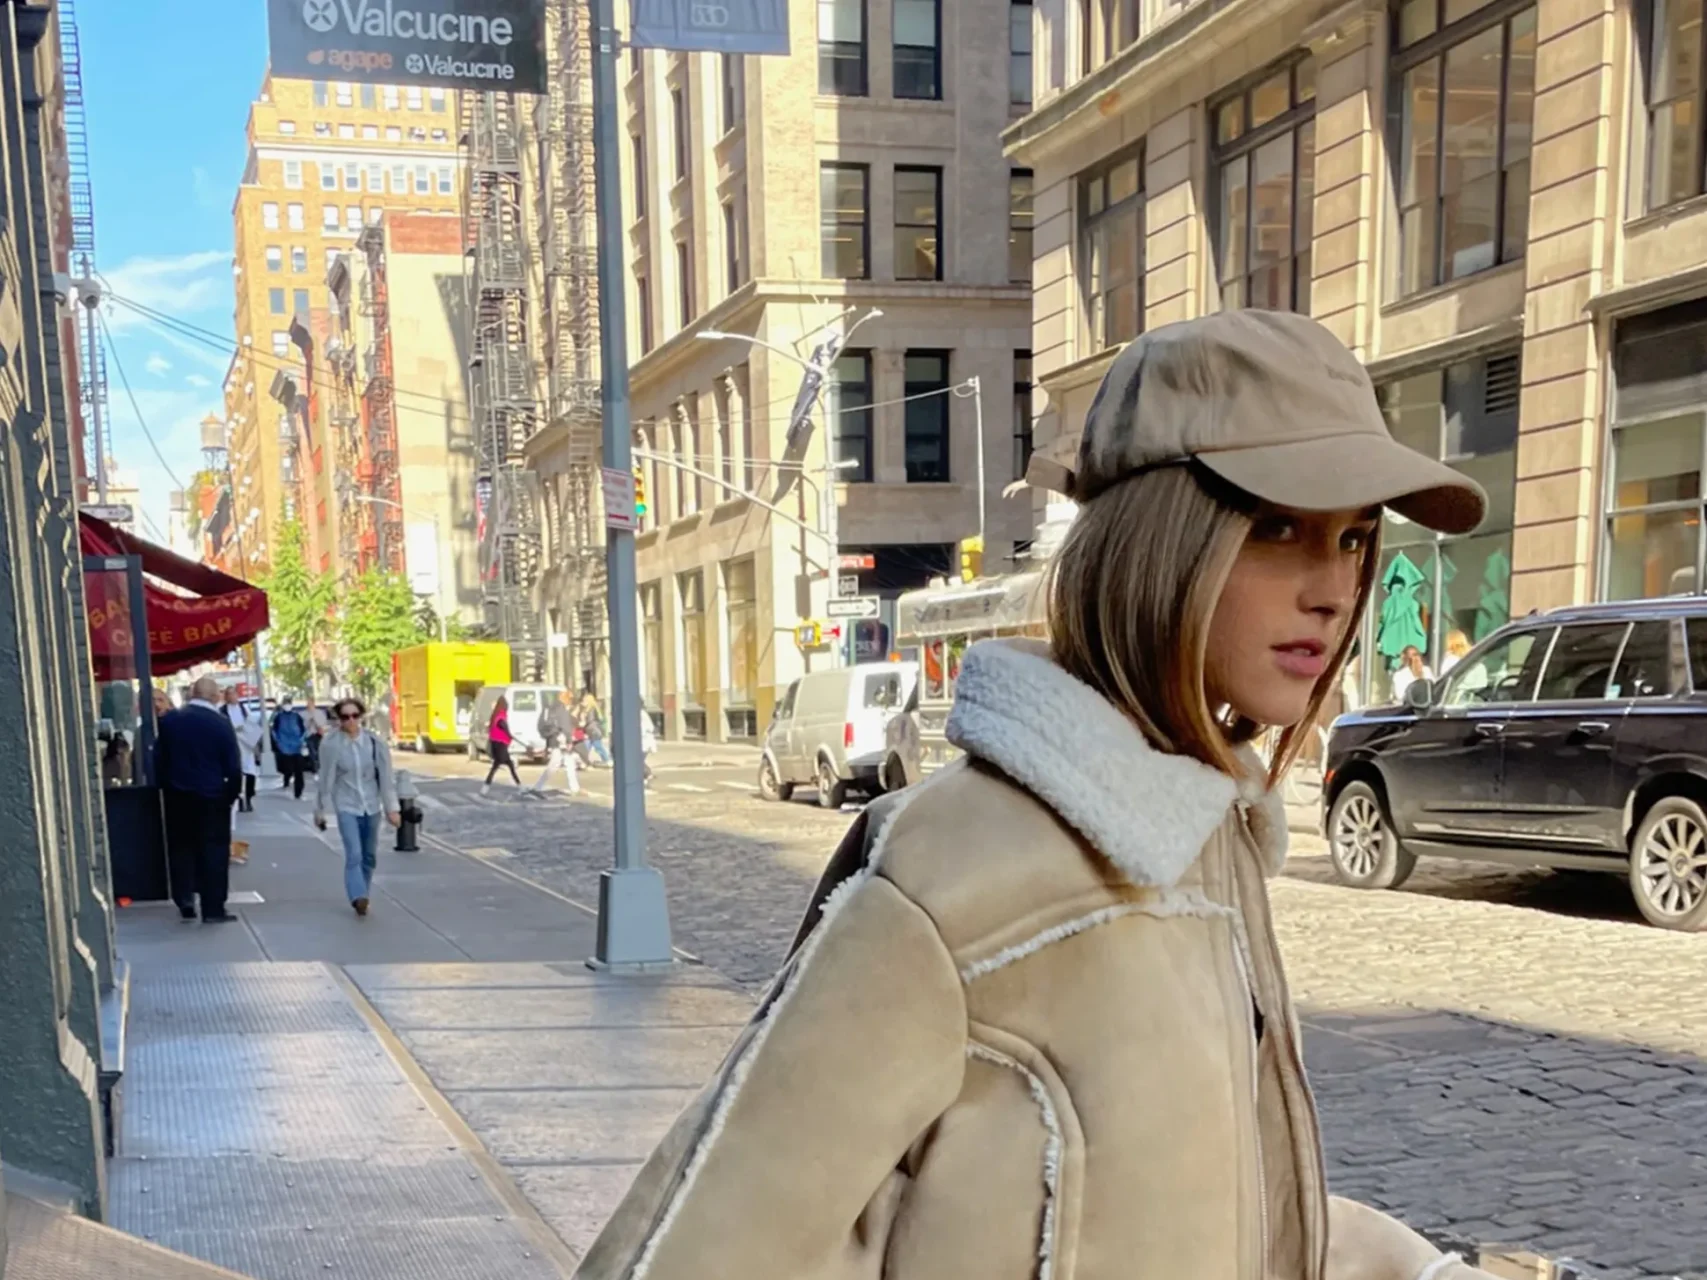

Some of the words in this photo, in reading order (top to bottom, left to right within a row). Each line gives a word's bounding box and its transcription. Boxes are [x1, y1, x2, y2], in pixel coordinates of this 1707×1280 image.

[341, 0, 513, 45] Valcucine
[328, 49, 393, 73] agape
[424, 54, 514, 79] Valcucine
[184, 616, 233, 643] BAR
